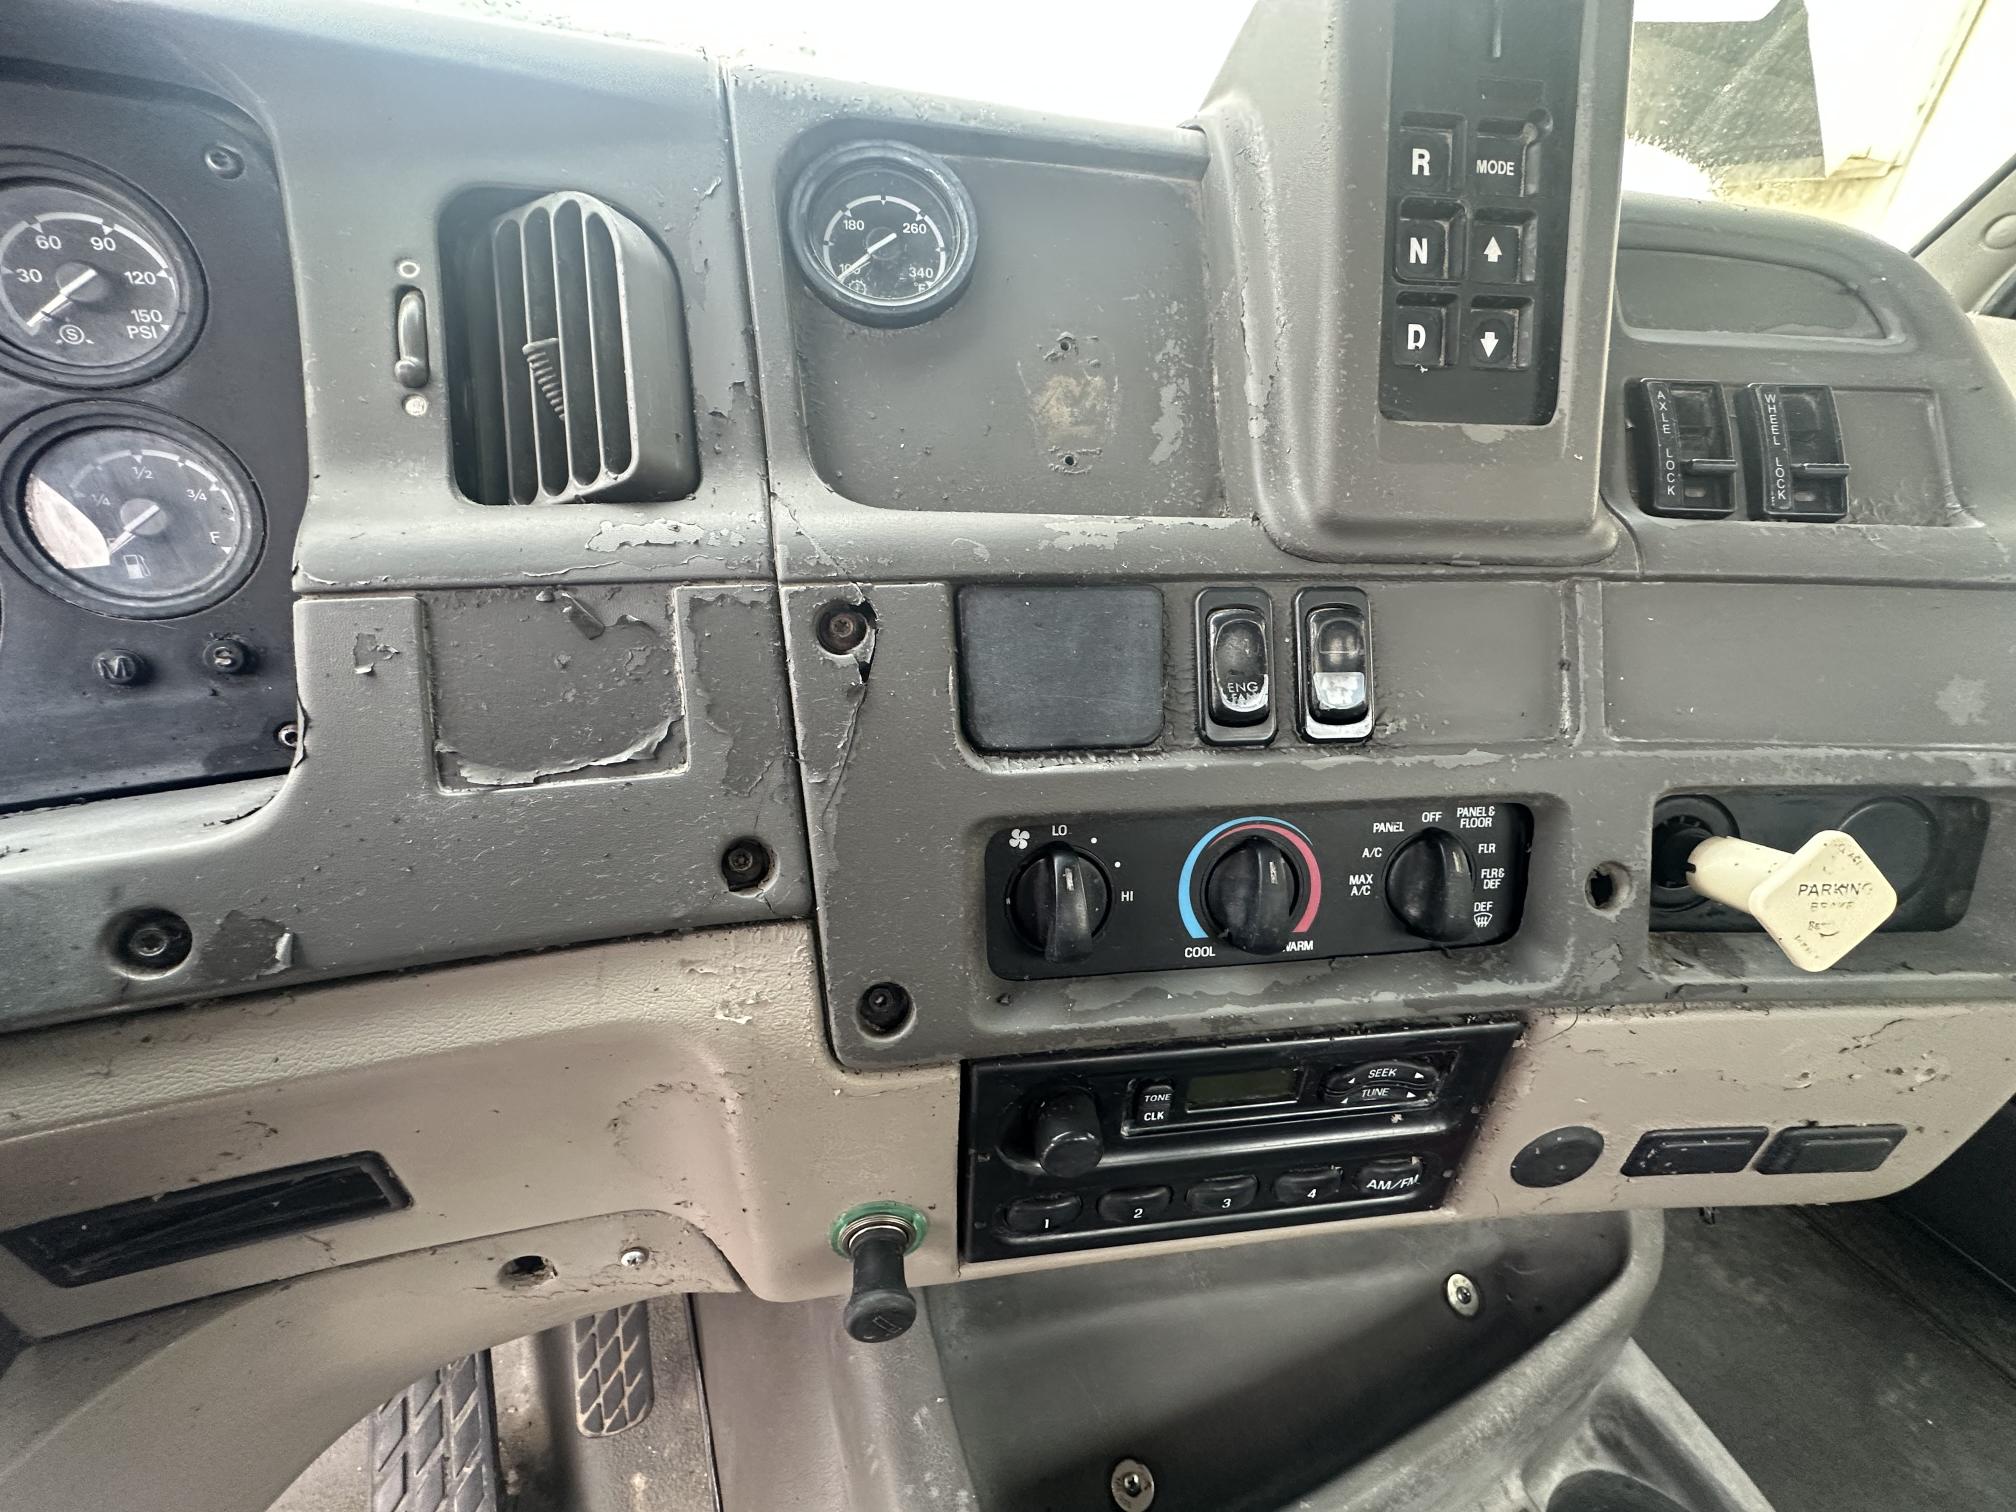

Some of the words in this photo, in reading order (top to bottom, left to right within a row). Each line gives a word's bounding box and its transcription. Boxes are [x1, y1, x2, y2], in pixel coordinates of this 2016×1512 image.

[1411, 148, 1431, 176] R
[1476, 159, 1515, 176] MODE
[843, 219, 865, 231] 180
[902, 223, 927, 234] 260
[35, 235, 62, 250] 60
[90, 236, 116, 251] 90
[1409, 237, 1428, 265] N
[16, 268, 43, 283] 30
[125, 271, 156, 286] 120
[909, 267, 934, 279] 340
[131, 309, 163, 323] 150
[126, 325, 157, 340] PSI
[1407, 323, 1426, 350] D
[1657, 390, 1671, 434] AXLE
[1666, 449, 1675, 496] LOCK
[1765, 394, 1781, 446] WHEEL
[1775, 457, 1786, 500] LOCK
[131, 466, 153, 480] 1/2
[187, 489, 208, 502] 3/4
[209, 530, 220, 545] F
[214, 647, 233, 666] S
[96, 656, 127, 680] M
[1227, 681, 1259, 692] ENG
[1422, 812, 1443, 823] OFF
[1457, 807, 1488, 817] PANEL
[1372, 822, 1405, 833] PANEL
[1460, 817, 1493, 829] FLOOR
[1051, 824, 1068, 836] LO
[1362, 847, 1383, 858] A/C
[1478, 843, 1497, 854] FLR
[1349, 874, 1374, 885] MAX
[1483, 879, 1502, 889] DEF
[1350, 886, 1371, 896] A/C
[1798, 882, 1874, 896] PARKING
[1121, 891, 1134, 902] HI
[1474, 902, 1493, 912] DEF
[1184, 946, 1215, 958] COOL
[1368, 1068, 1397, 1078] SEEK
[1144, 1093, 1171, 1102] TONE
[1361, 1088, 1390, 1098] TUNE
[1143, 1111, 1164, 1121] CLK
[1366, 1174, 1419, 1190] AM/FM
[1307, 1188, 1316, 1198] 4
[1221, 1198, 1231, 1208] 3
[1133, 1208, 1143, 1219] 2
[1044, 1218, 1049, 1229] 1
